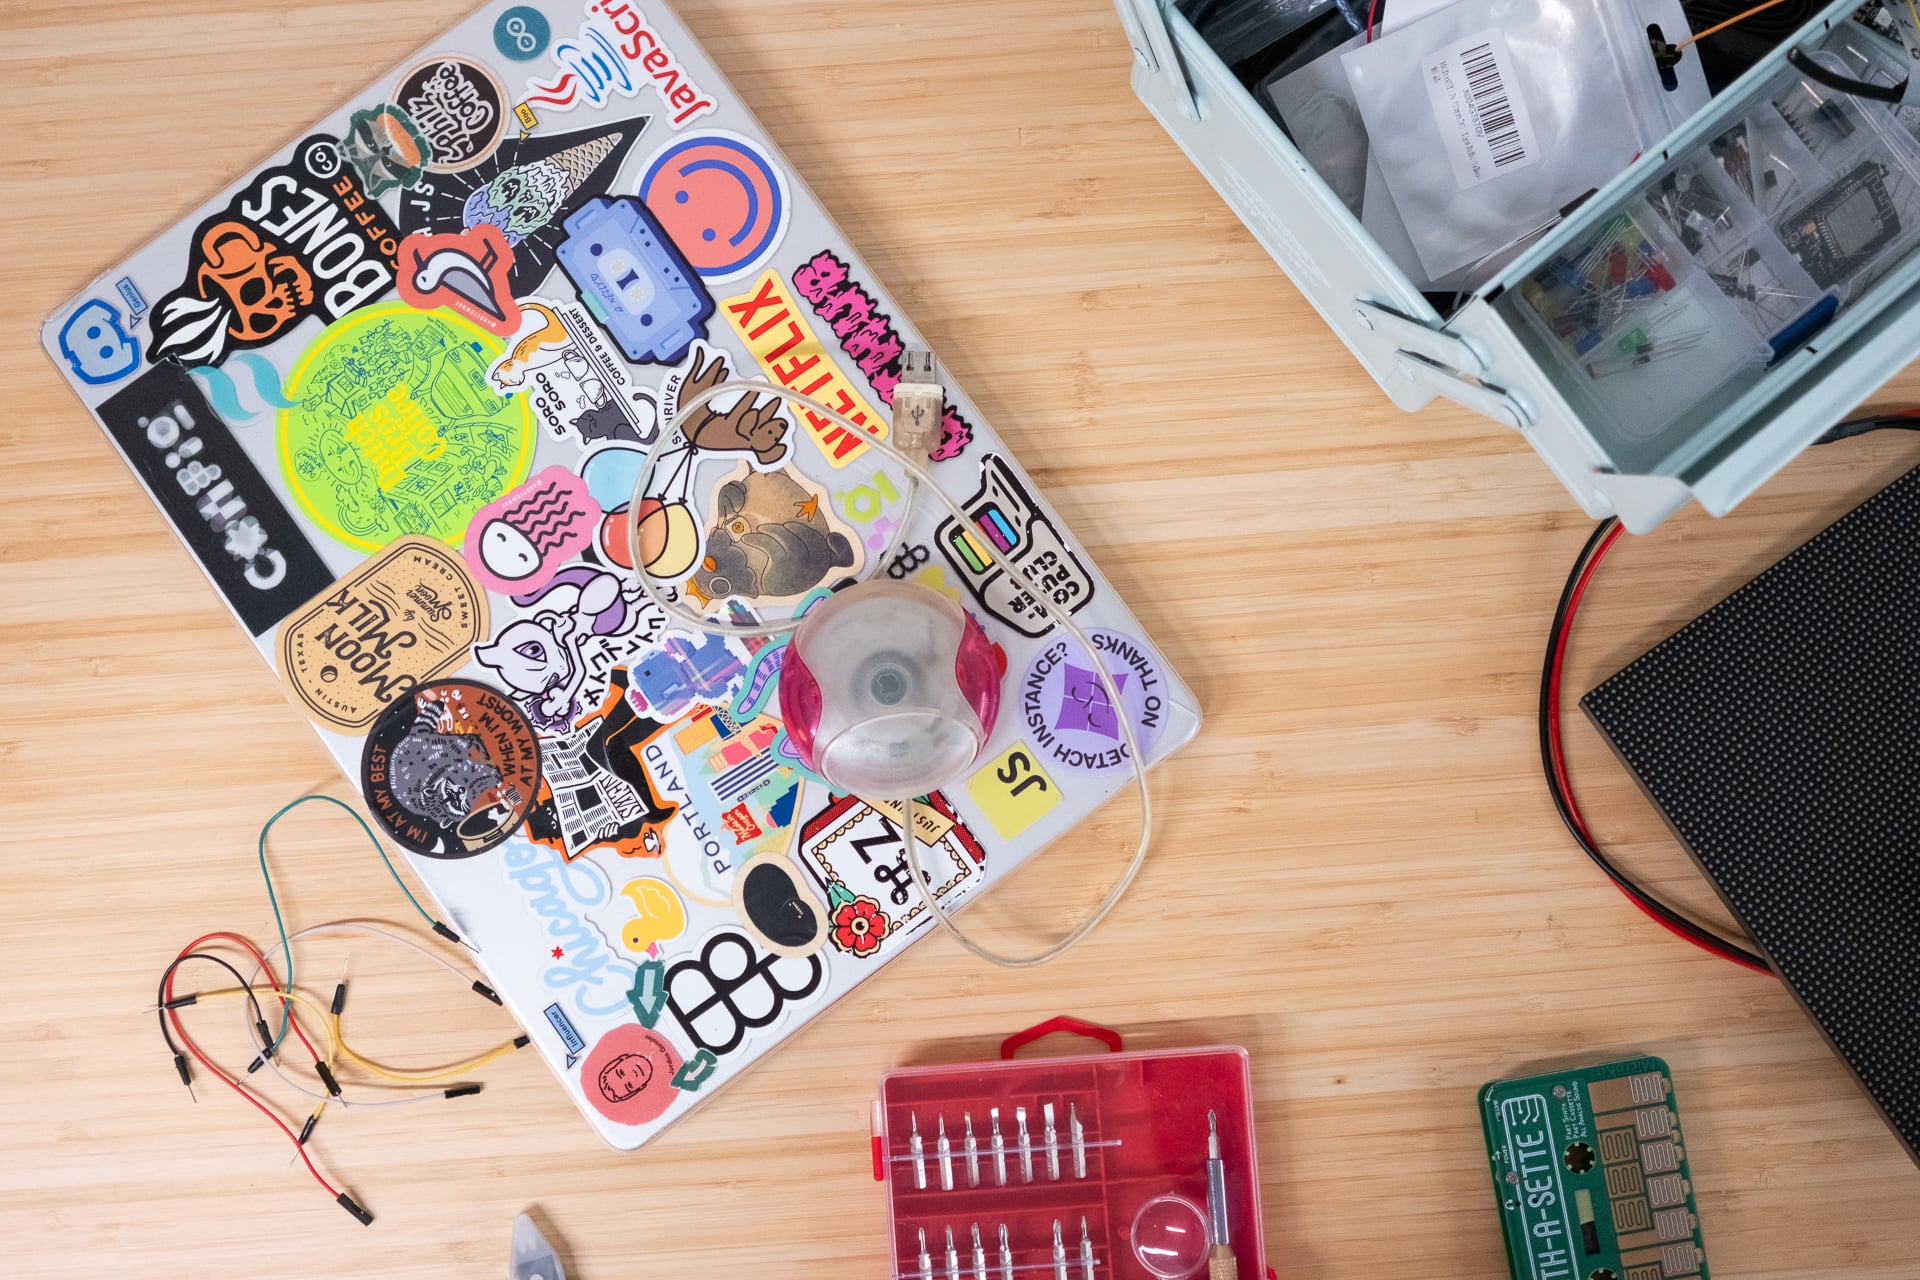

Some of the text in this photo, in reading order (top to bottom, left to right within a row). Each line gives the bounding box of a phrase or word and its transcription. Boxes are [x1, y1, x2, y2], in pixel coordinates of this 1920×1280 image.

[436, 62, 486, 132] Coffee
[242, 175, 392, 320] BONES
[122, 284, 141, 308] Genius
[568, 308, 598, 346] DESSERT
[535, 372, 566, 411] SORO
[598, 351, 626, 386] COFFEE
[727, 278, 879, 460] NETFLIX
[362, 401, 419, 467] Bros
[381, 381, 448, 462] Coffee
[535, 397, 566, 435] SORO
[663, 374, 682, 445] SNRIVER
[345, 411, 406, 492] Dutch
[413, 555, 469, 629] SWEET CREAM
[1007, 564, 1071, 613] PUER
[297, 633, 357, 714] AUSTIN TEXAS
[1024, 642, 1068, 749] INSTANCE?
[1091, 634, 1161, 728] NO THANKS
[475, 693, 534, 787] AT MY WORST
[479, 711, 516, 777] WHEN I'M
[997, 751, 1047, 797] JS
[371, 744, 428, 844] I'M AT MY BEST
[645, 744, 732, 875] PORTLAND
[503, 840, 637, 1015] Chicago
[551, 1010, 577, 1047] Influencer
